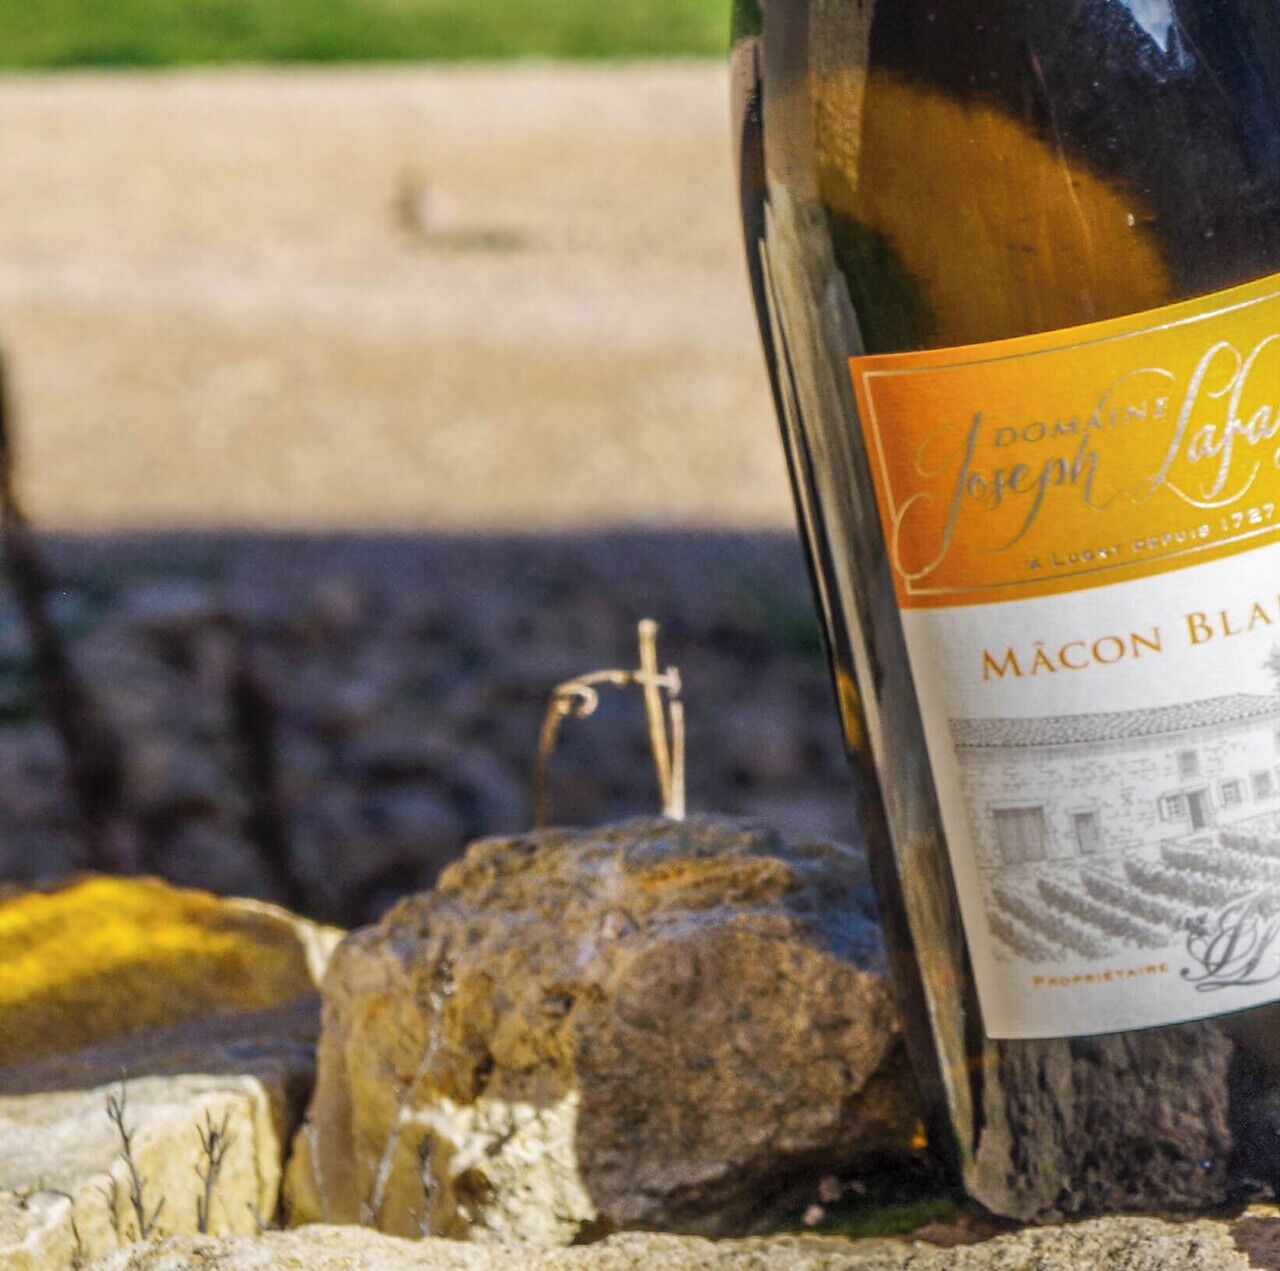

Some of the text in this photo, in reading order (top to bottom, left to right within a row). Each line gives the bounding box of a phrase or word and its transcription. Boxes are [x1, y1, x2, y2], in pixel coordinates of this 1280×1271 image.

[993, 396, 1170, 448] DOMAINE
[892, 367, 1176, 580] Joseph
[1220, 503, 1275, 533] 1727
[982, 626, 1164, 682] MÂCON
[1031, 961, 1170, 989] PROPRIÉTAIRE
